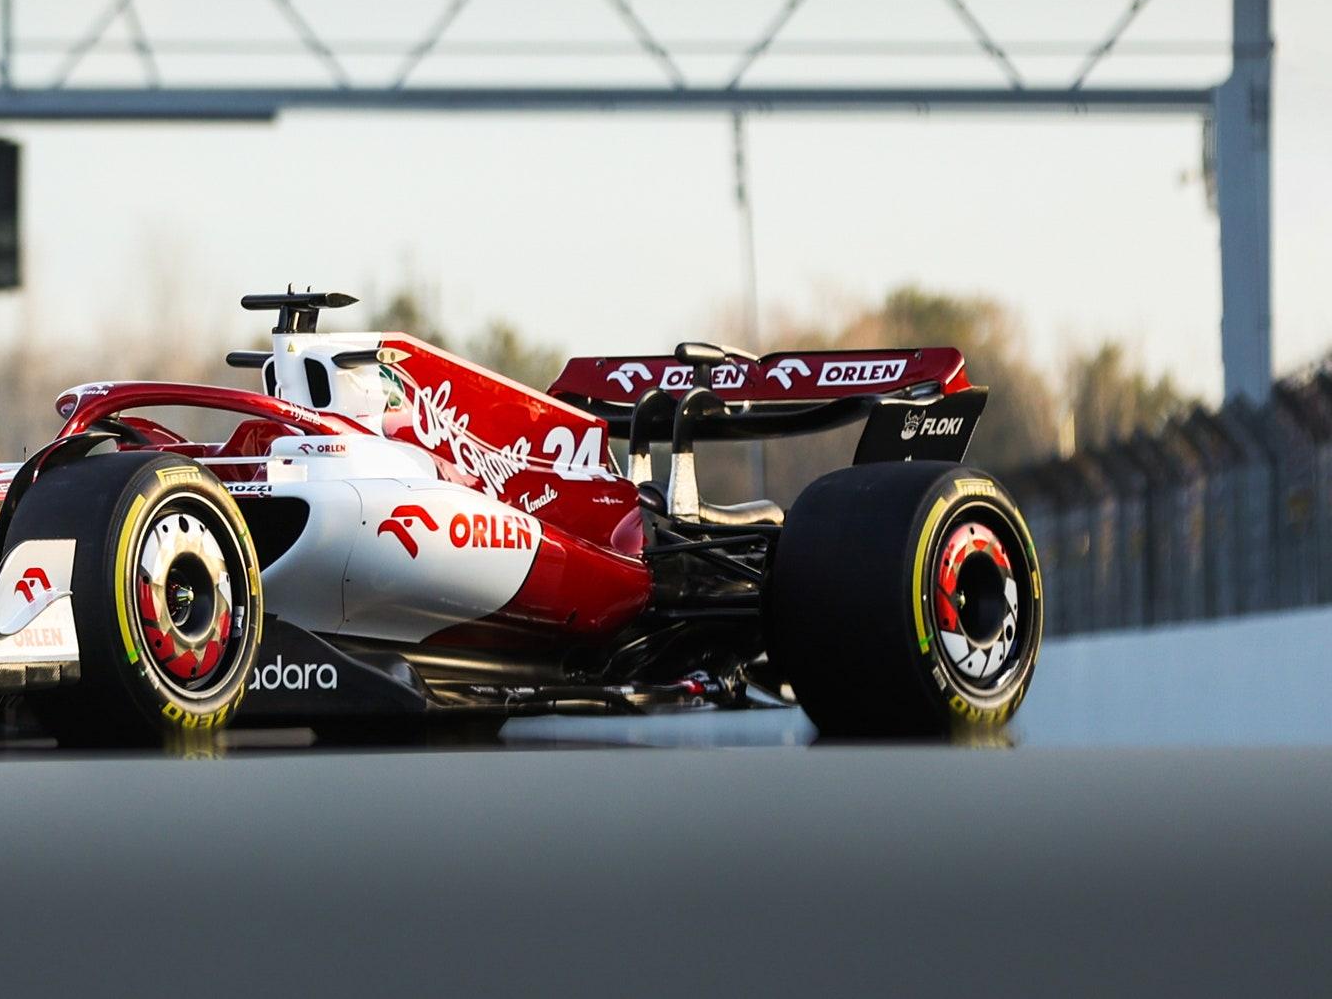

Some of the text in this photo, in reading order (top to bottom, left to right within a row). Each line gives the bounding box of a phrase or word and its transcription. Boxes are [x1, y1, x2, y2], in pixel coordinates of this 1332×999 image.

[667, 369, 740, 386] OREN
[825, 362, 900, 381] ORLEN
[920, 417, 964, 435] FLOKI
[317, 444, 346, 453] ORLEN
[542, 426, 617, 481] 24
[155, 466, 202, 487] PIRELLI
[519, 484, 558, 513] Tonale
[449, 513, 532, 550] ORLEN
[14, 628, 64, 647] ORLEN
[248, 654, 338, 690] adara
